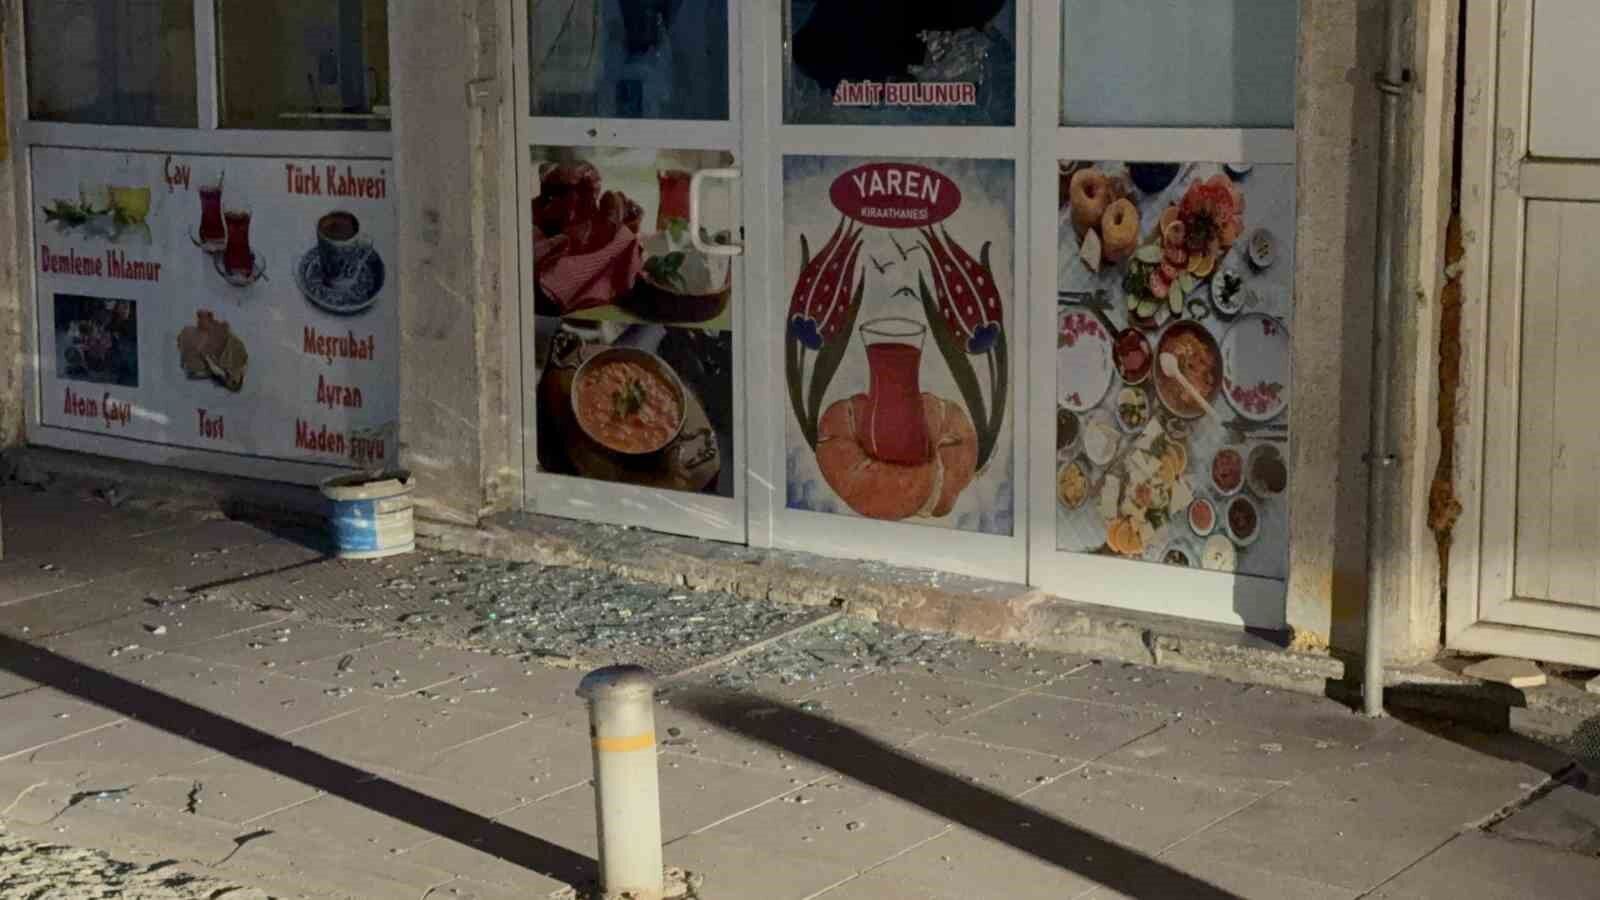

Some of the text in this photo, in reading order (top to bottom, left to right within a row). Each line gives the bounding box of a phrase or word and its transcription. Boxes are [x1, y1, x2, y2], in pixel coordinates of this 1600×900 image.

[885, 82, 976, 106] BULUNUR
[164, 155, 191, 194] Çay
[286, 163, 386, 199] Türk Kahvesi
[852, 168, 940, 204] YAREN
[41, 244, 103, 277] Demleme
[303, 325, 375, 365] Meşrubat
[63, 386, 98, 417] Atom
[317, 373, 363, 409] Ayran
[197, 407, 225, 439] Tost
[295, 416, 345, 454] Maden
